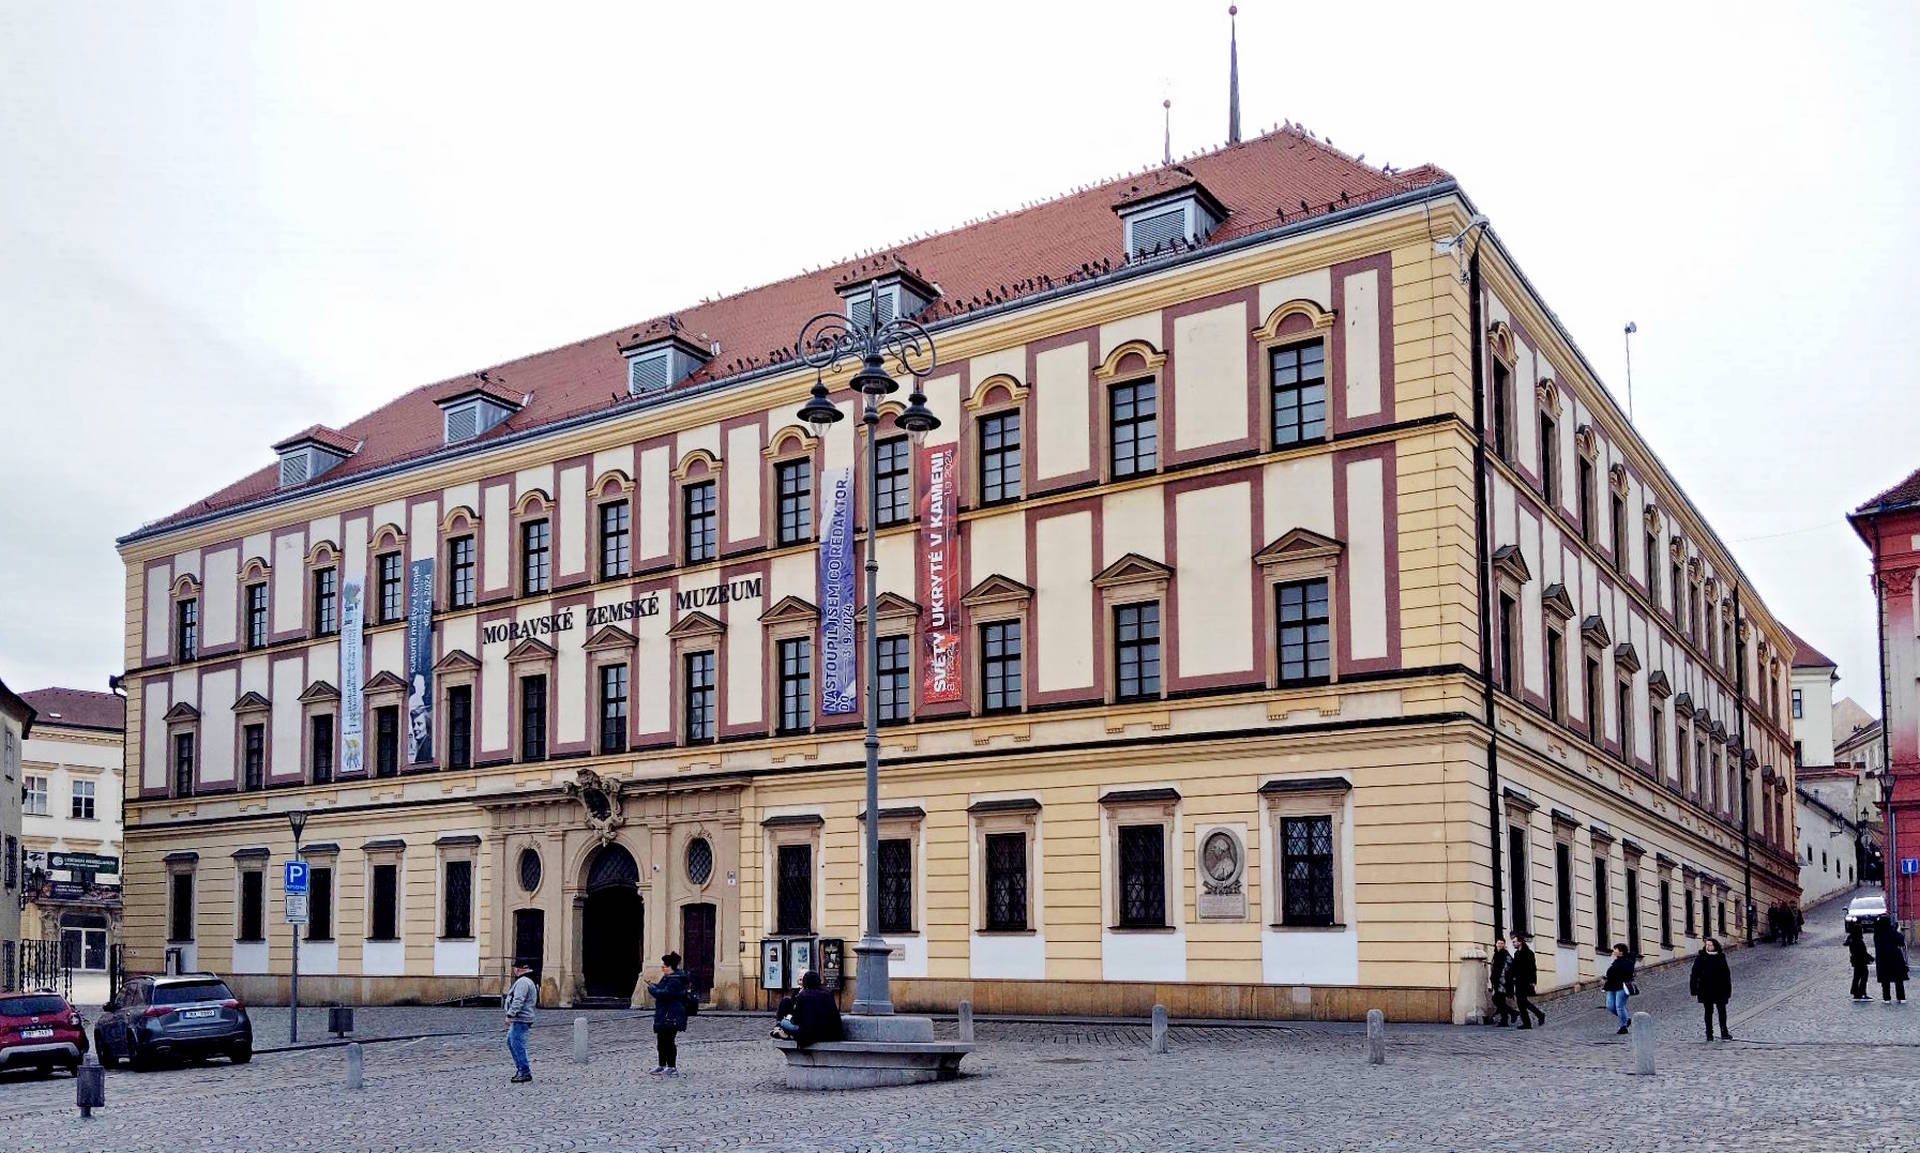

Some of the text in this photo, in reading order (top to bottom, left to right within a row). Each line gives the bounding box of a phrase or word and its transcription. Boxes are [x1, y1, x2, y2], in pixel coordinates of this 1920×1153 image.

[828, 561, 841, 580] CO
[928, 452, 947, 692] SVĚTY UKRYTÉ V KAMENI
[411, 606, 419, 635] mosty
[483, 577, 762, 645] MORAVSKÉ ZEMSKÉ MUZEUM
[827, 585, 841, 625] JSEM
[823, 626, 839, 711] NASTOUPIL
[840, 695, 850, 711] DO
[290, 865, 303, 883] P
